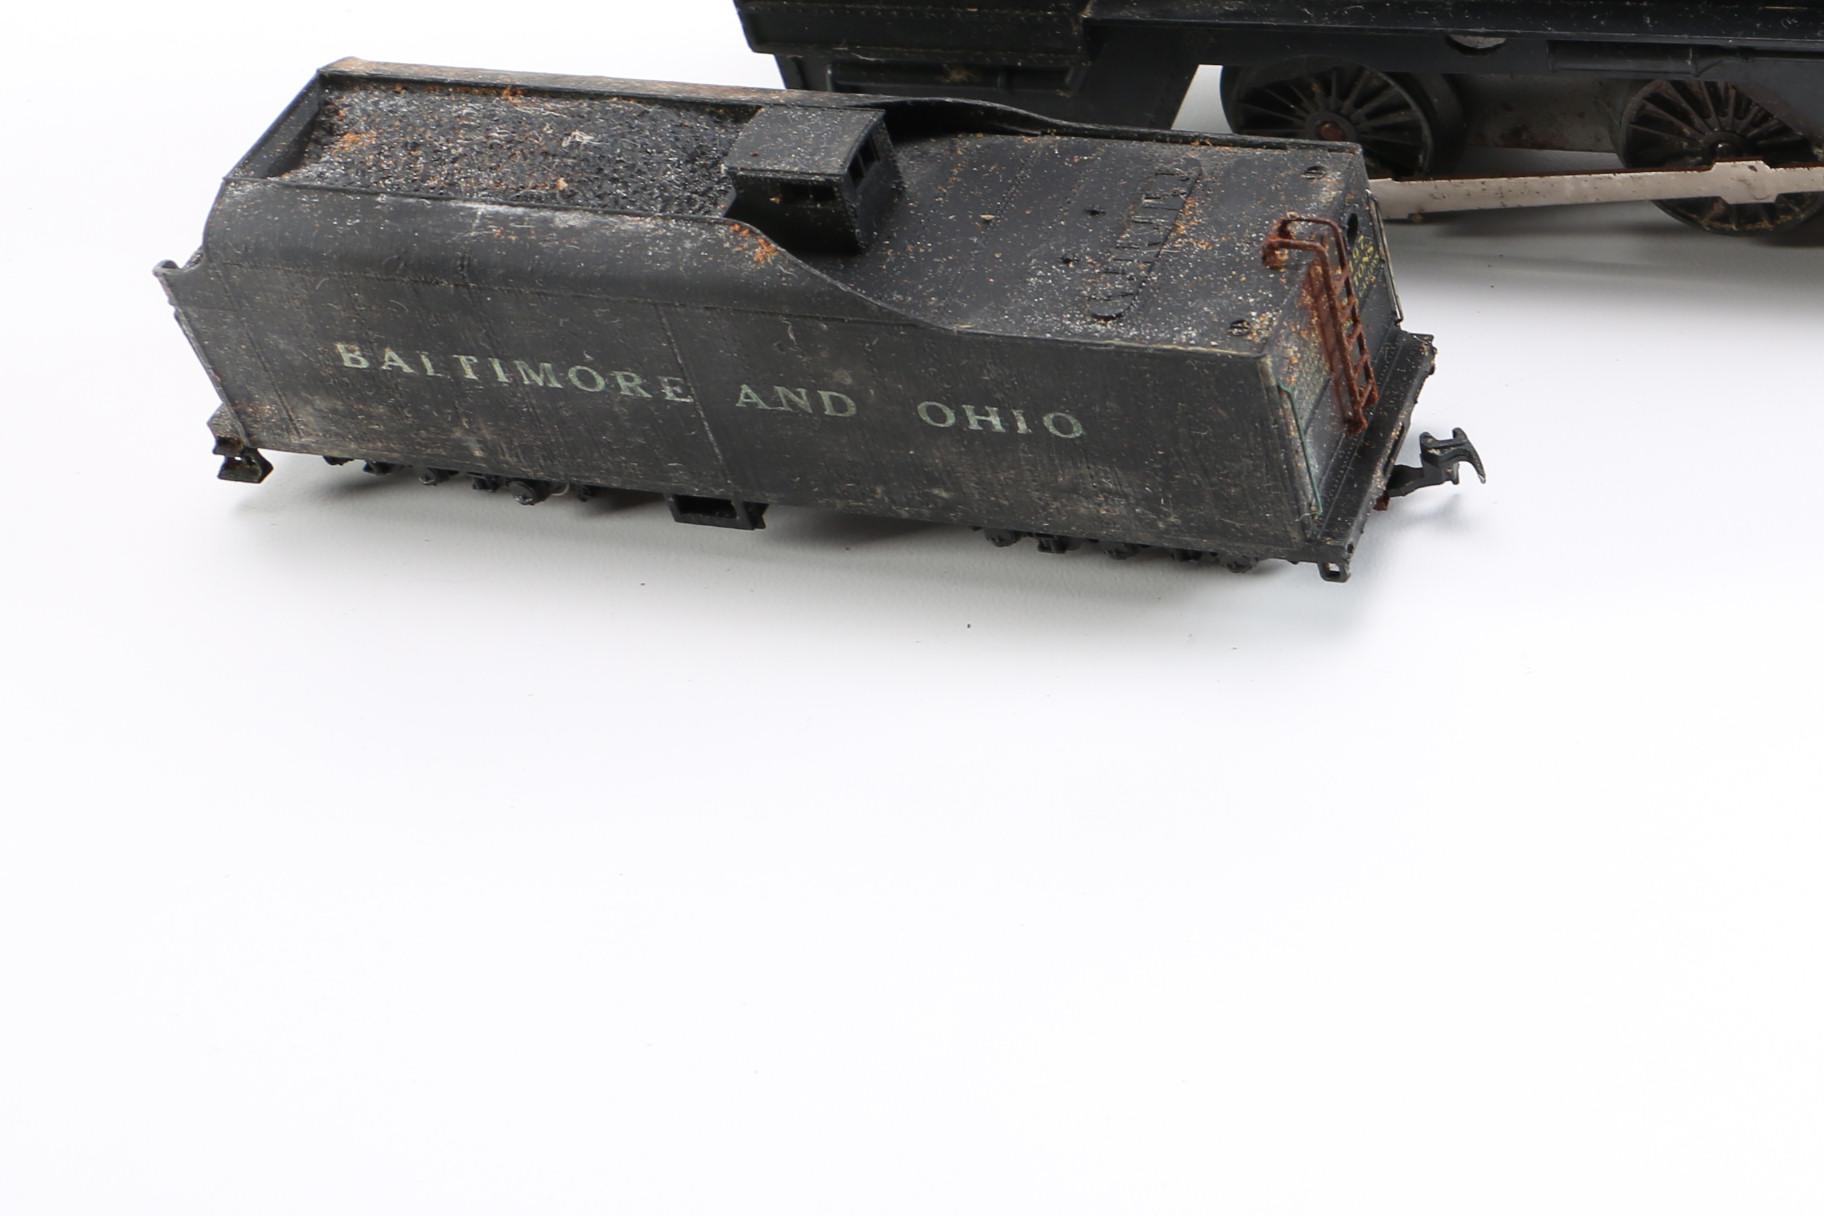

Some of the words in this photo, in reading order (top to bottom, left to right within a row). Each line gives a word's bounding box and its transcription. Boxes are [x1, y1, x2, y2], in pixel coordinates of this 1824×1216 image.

[334, 341, 693, 404] BALTIMORE
[735, 383, 857, 418] AND
[918, 400, 1085, 440] OHIO
